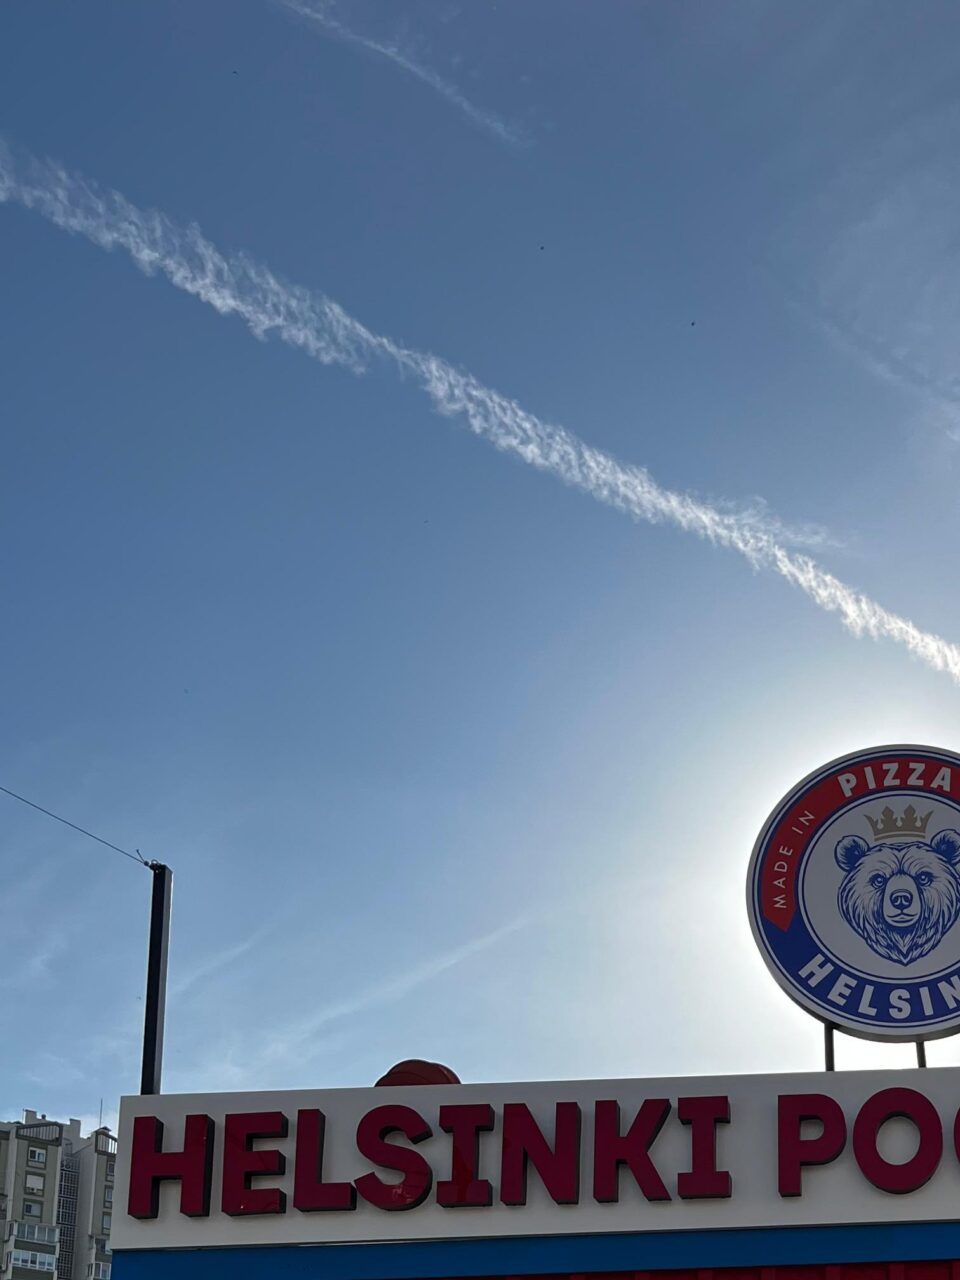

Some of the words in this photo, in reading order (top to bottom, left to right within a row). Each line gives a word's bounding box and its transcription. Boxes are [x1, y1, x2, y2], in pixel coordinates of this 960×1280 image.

[837, 762, 952, 797] PIZZA
[772, 845, 793, 909] MADE
[791, 810, 815, 834] IN
[127, 1095, 732, 1219] HELSINKI
